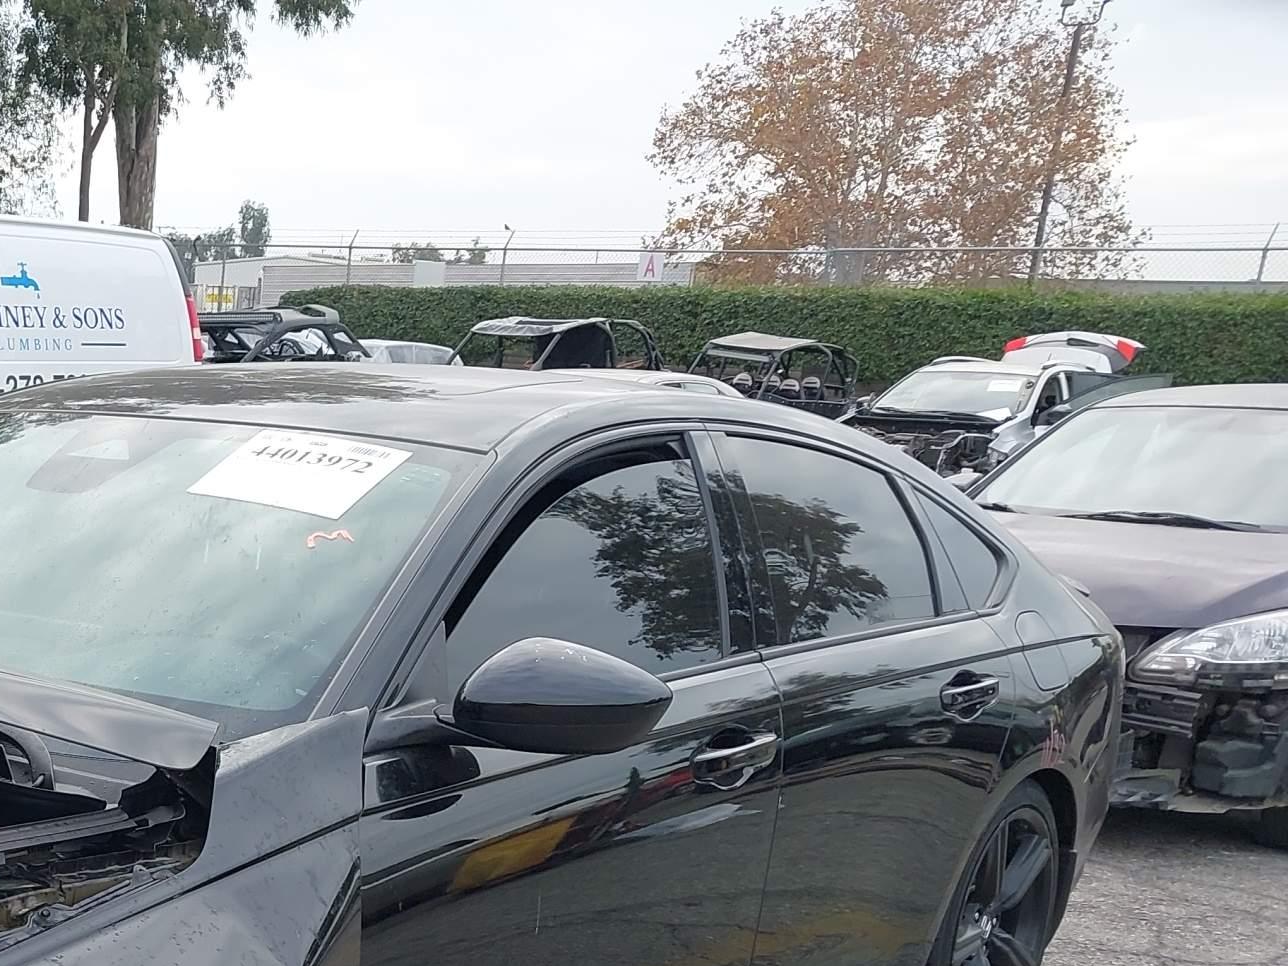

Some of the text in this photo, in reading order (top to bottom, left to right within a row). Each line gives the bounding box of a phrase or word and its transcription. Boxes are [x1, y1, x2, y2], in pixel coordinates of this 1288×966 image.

[643, 255, 655, 278] A
[52, 307, 69, 329] &
[72, 307, 125, 330] SONS
[251, 445, 373, 474] 44013972
